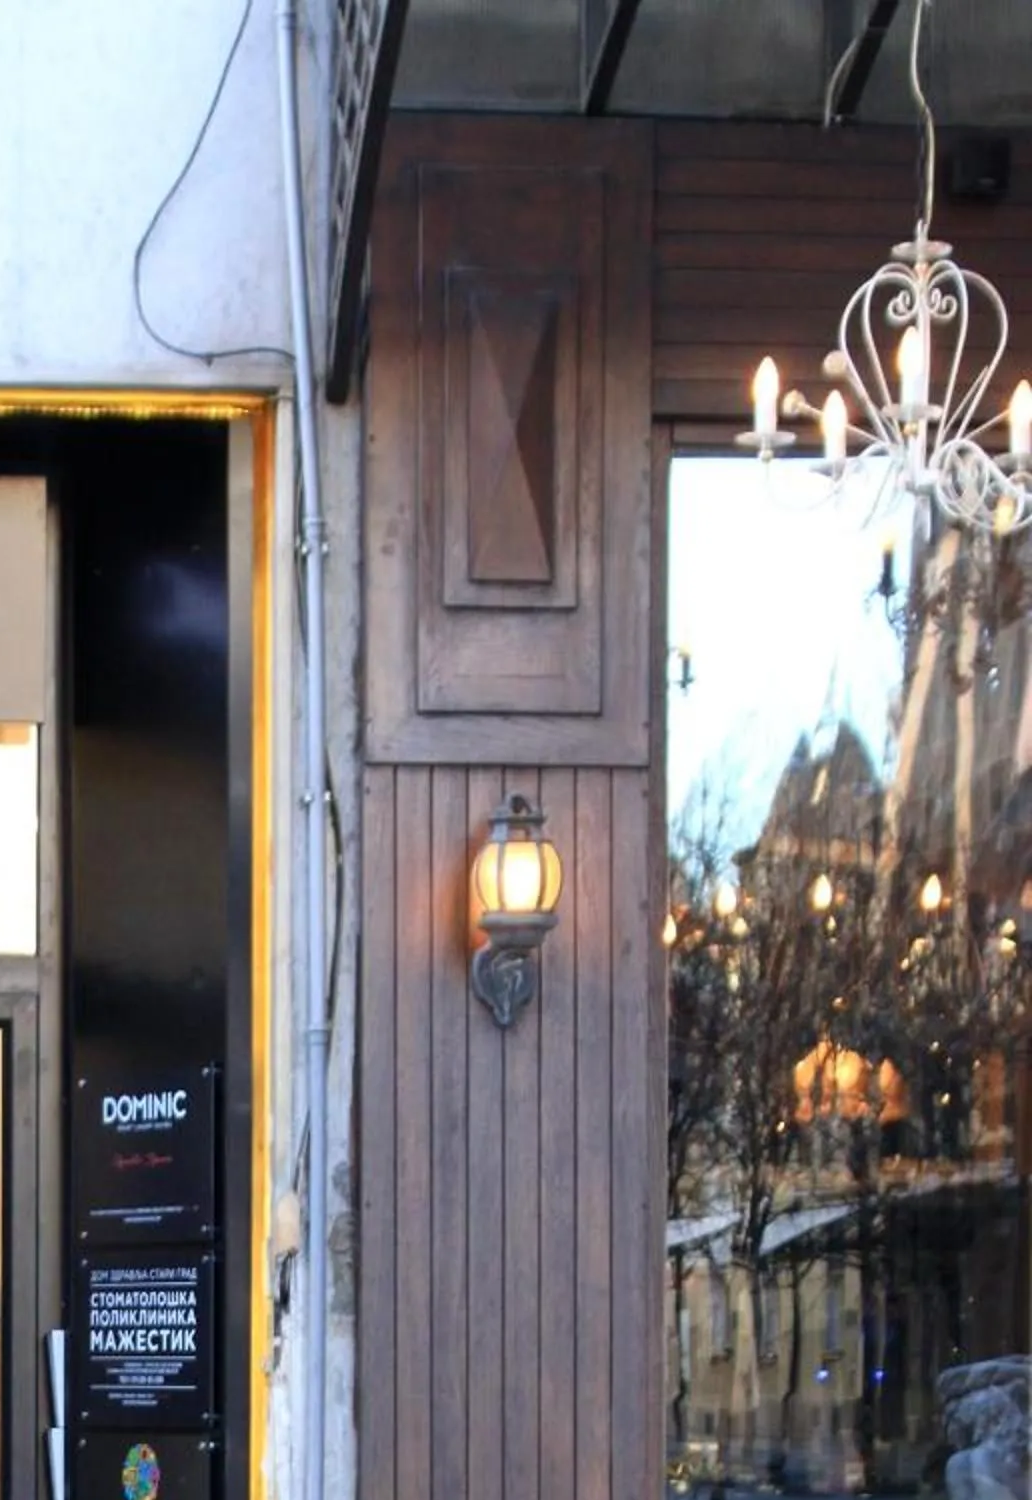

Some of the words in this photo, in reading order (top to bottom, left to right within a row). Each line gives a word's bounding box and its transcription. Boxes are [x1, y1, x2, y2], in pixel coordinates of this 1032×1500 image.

[102, 1089, 188, 1125] DOMINIC
[91, 1291, 196, 1308] СТОМАТОЛОШКА
[91, 1308, 196, 1327] ПОЛИКЛИНИКА
[90, 1328, 196, 1352] МАЖЕСТИК
